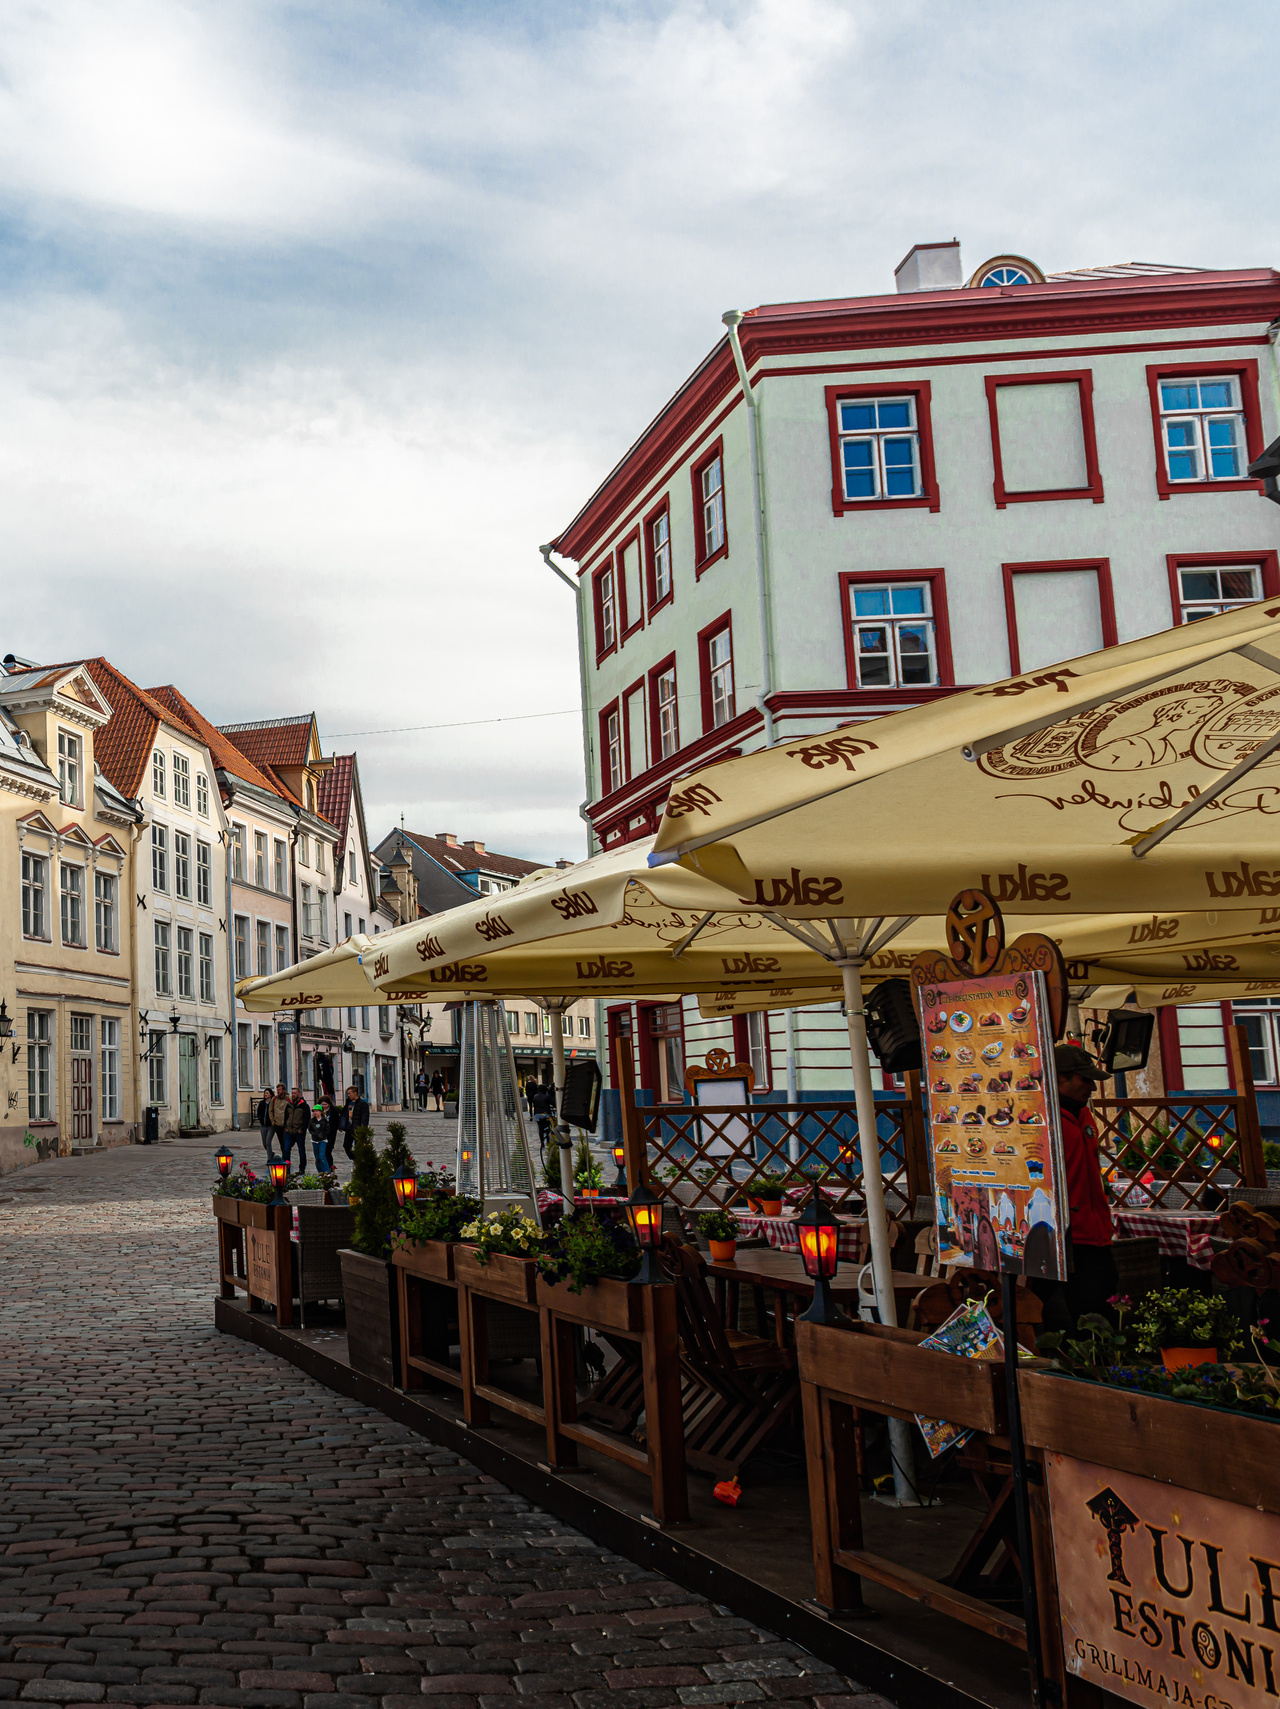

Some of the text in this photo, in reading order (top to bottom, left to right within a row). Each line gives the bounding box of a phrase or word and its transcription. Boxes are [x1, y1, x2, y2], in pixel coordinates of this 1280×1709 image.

[550, 887, 599, 921] saku
[475, 911, 515, 942] saku
[416, 932, 447, 962] saku
[373, 952, 390, 980] saku
[997, 988, 1015, 998] MENU
[1109, 1588, 1280, 1697] ESTONI
